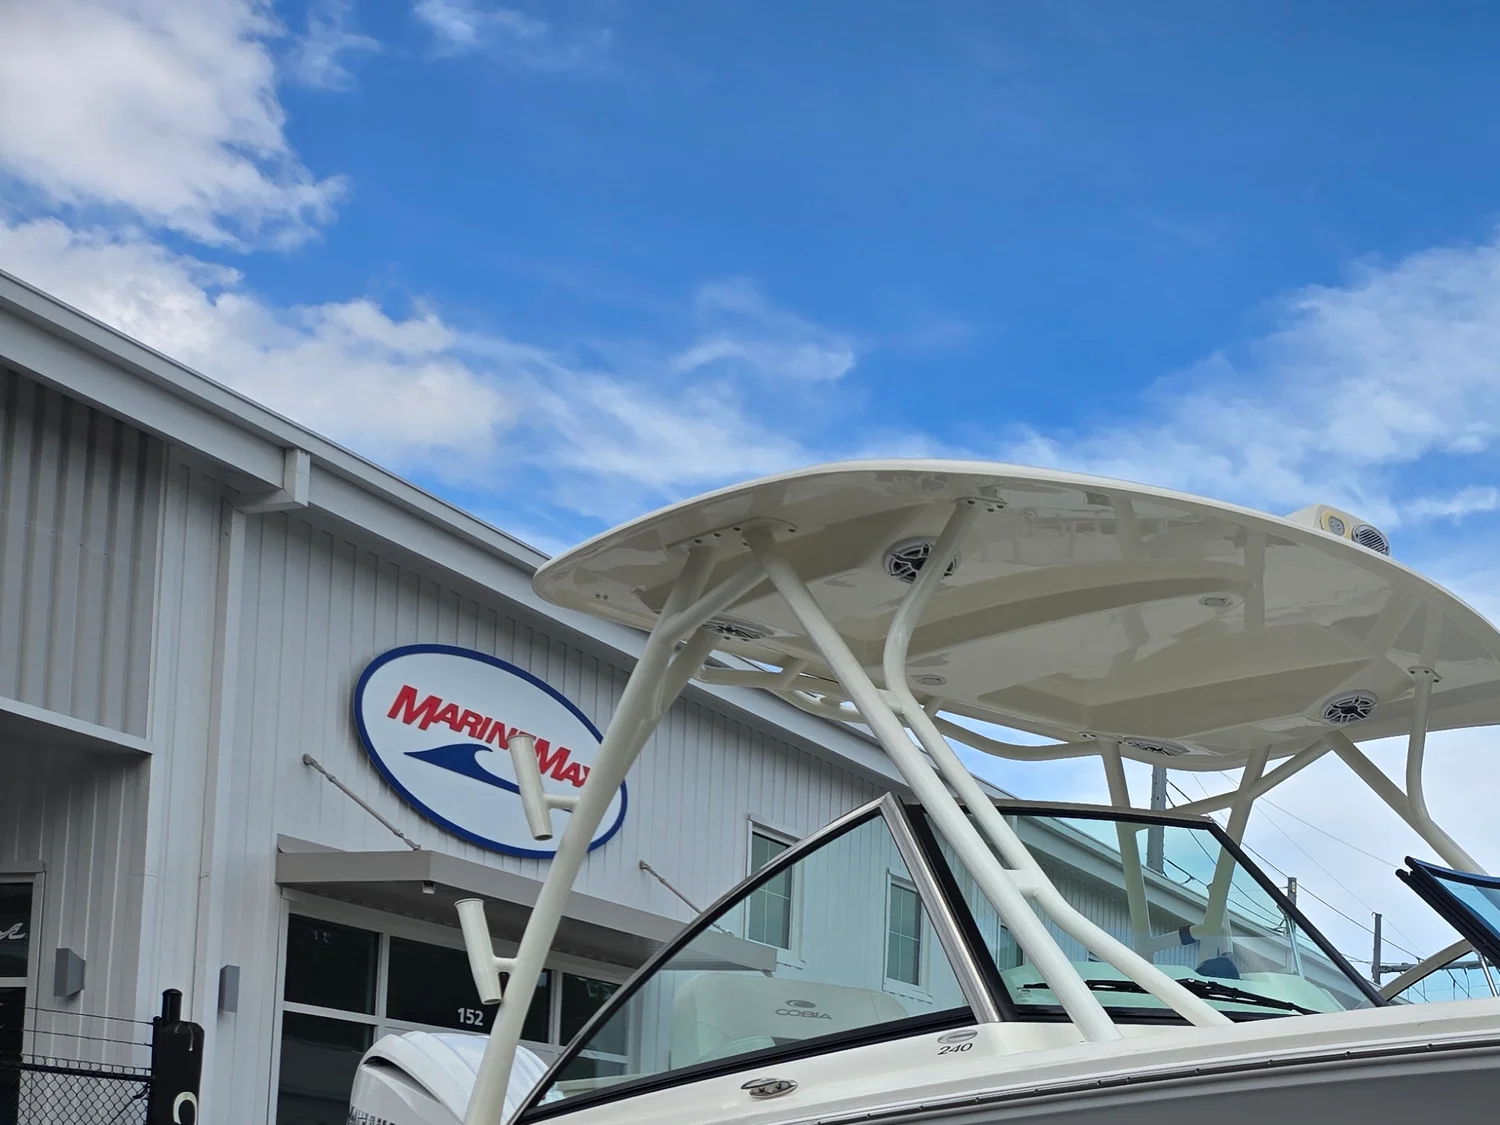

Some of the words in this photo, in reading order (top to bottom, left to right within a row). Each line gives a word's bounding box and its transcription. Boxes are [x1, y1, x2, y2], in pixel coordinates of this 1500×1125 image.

[387, 684, 591, 788] MARINMA
[457, 1007, 484, 1027] 152
[775, 1008, 833, 1020] COBIA
[937, 1042, 973, 1056] 240
